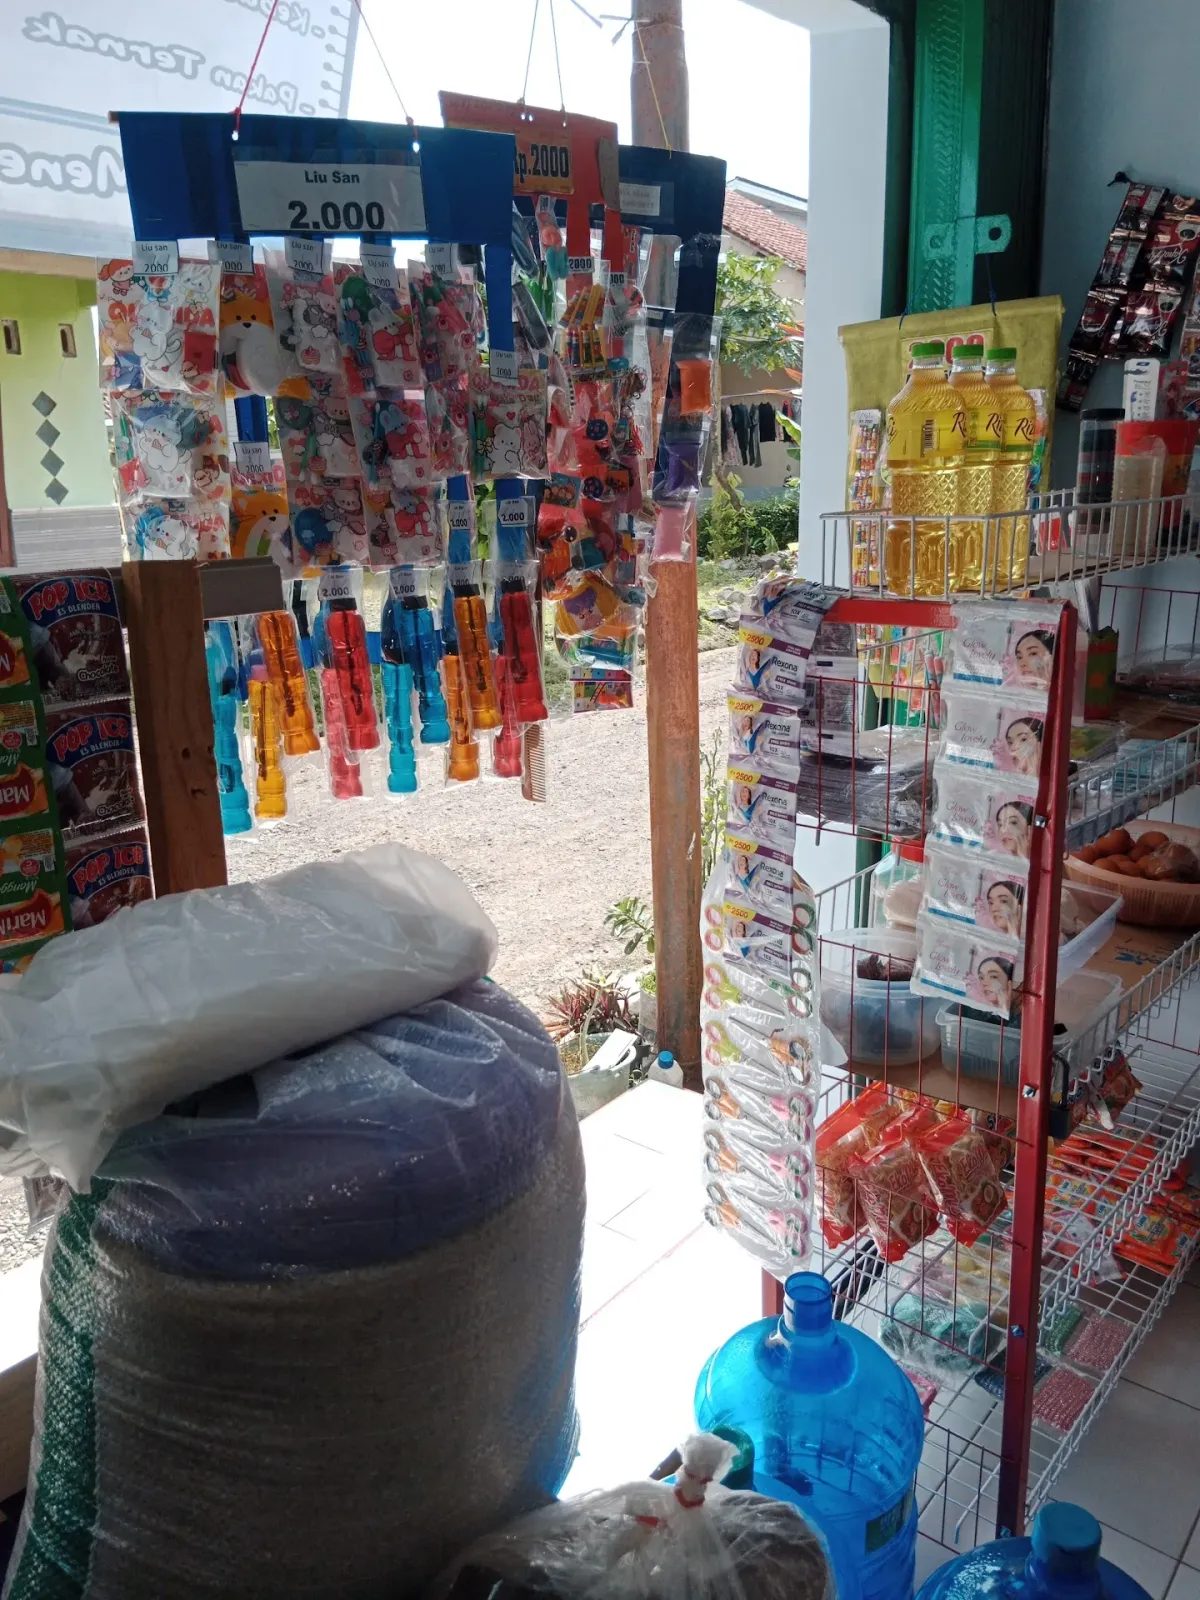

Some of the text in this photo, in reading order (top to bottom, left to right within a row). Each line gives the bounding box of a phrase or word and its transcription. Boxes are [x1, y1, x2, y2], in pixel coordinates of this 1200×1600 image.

[305, 171, 360, 184] Liu San
[288, 200, 385, 230] 2.000
[144, 263, 169, 273] 2000
[223, 261, 243, 271] 000
[568, 258, 592, 269] 2000
[501, 512, 525, 521] 2.000
[322, 587, 350, 597] 2.000
[393, 585, 415, 594] 2.000
[28, 581, 70, 620] POP
[57, 608, 66, 617] ES
[747, 634, 765, 645] 2500
[772, 655, 798, 672] Rexona
[765, 719, 791, 733] Rexona
[53, 721, 93, 762] POP
[736, 771, 753, 782] 2500
[762, 791, 787, 806] Rexona
[734, 841, 751, 851] 2500
[73, 852, 110, 894] POP
[760, 861, 784, 877] Rexona
[731, 907, 748, 918] 2500
